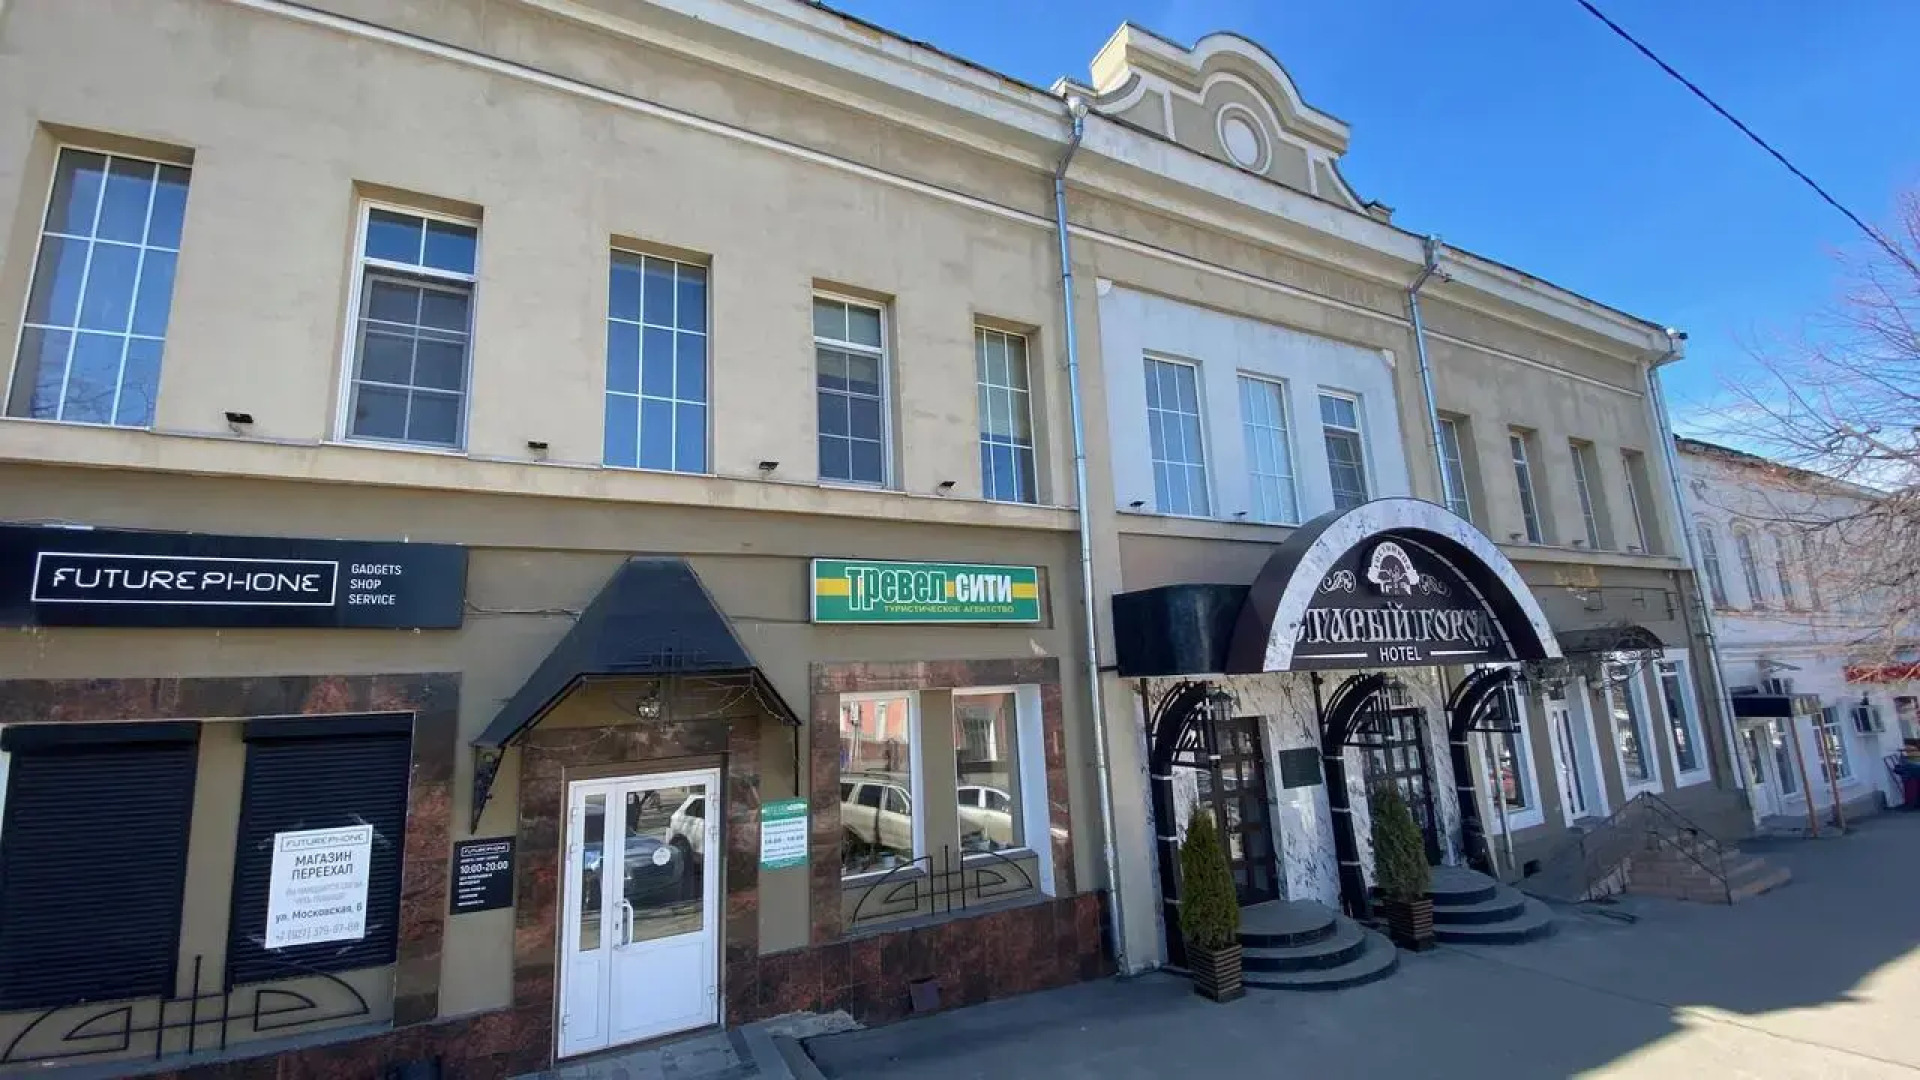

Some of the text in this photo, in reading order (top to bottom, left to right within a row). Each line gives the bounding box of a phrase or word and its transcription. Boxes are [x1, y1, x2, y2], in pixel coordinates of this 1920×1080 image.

[351, 564, 402, 575] GADGETS
[350, 578, 382, 589] SHOP
[956, 573, 1012, 603] СИТИ
[348, 594, 397, 605] SERVICE
[884, 605, 1015, 613] ТУРИСТИЧЕСКОЕ АГЕНТСТВО
[1379, 646, 1422, 662] HOTEL
[295, 851, 352, 867] МАГАЗИН
[291, 863, 354, 881] ПЕРЕЕХАЛ
